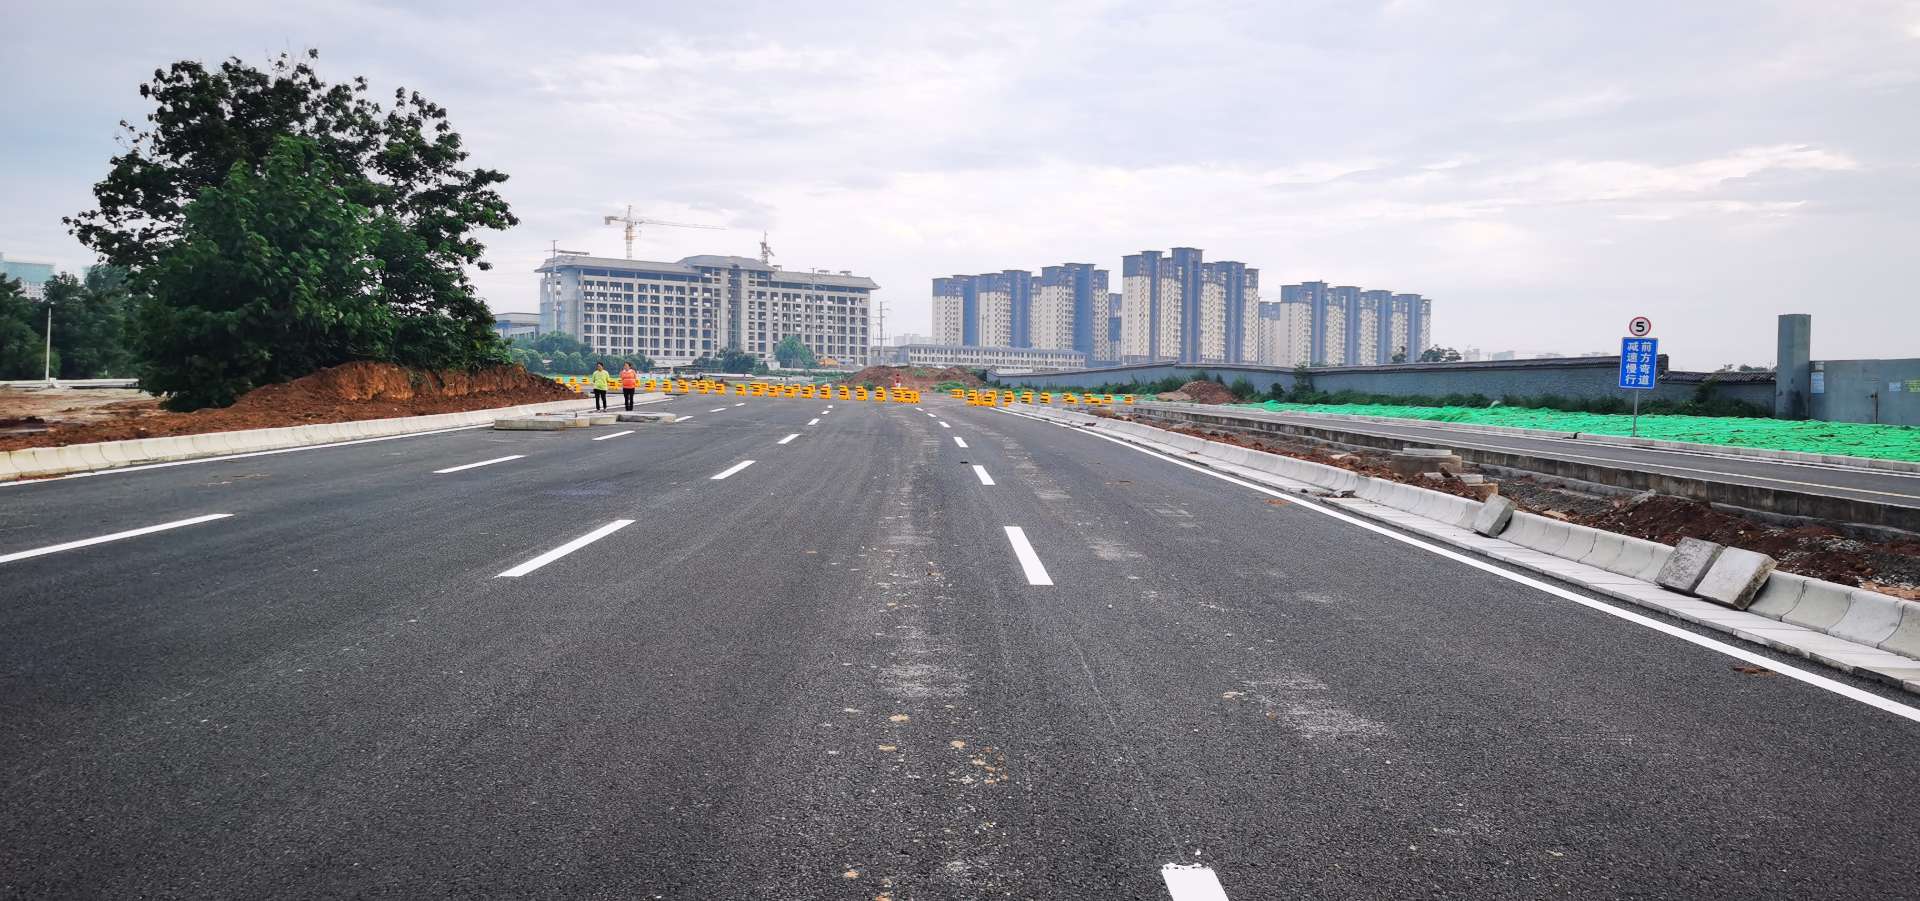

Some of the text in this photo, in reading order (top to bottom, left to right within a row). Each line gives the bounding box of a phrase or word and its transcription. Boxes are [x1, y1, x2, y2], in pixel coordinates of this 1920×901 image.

[1635, 321, 1645, 333] 5
[1625, 341, 1639, 385] 减速慢行
[1637, 341, 1653, 385] 前方弯道
